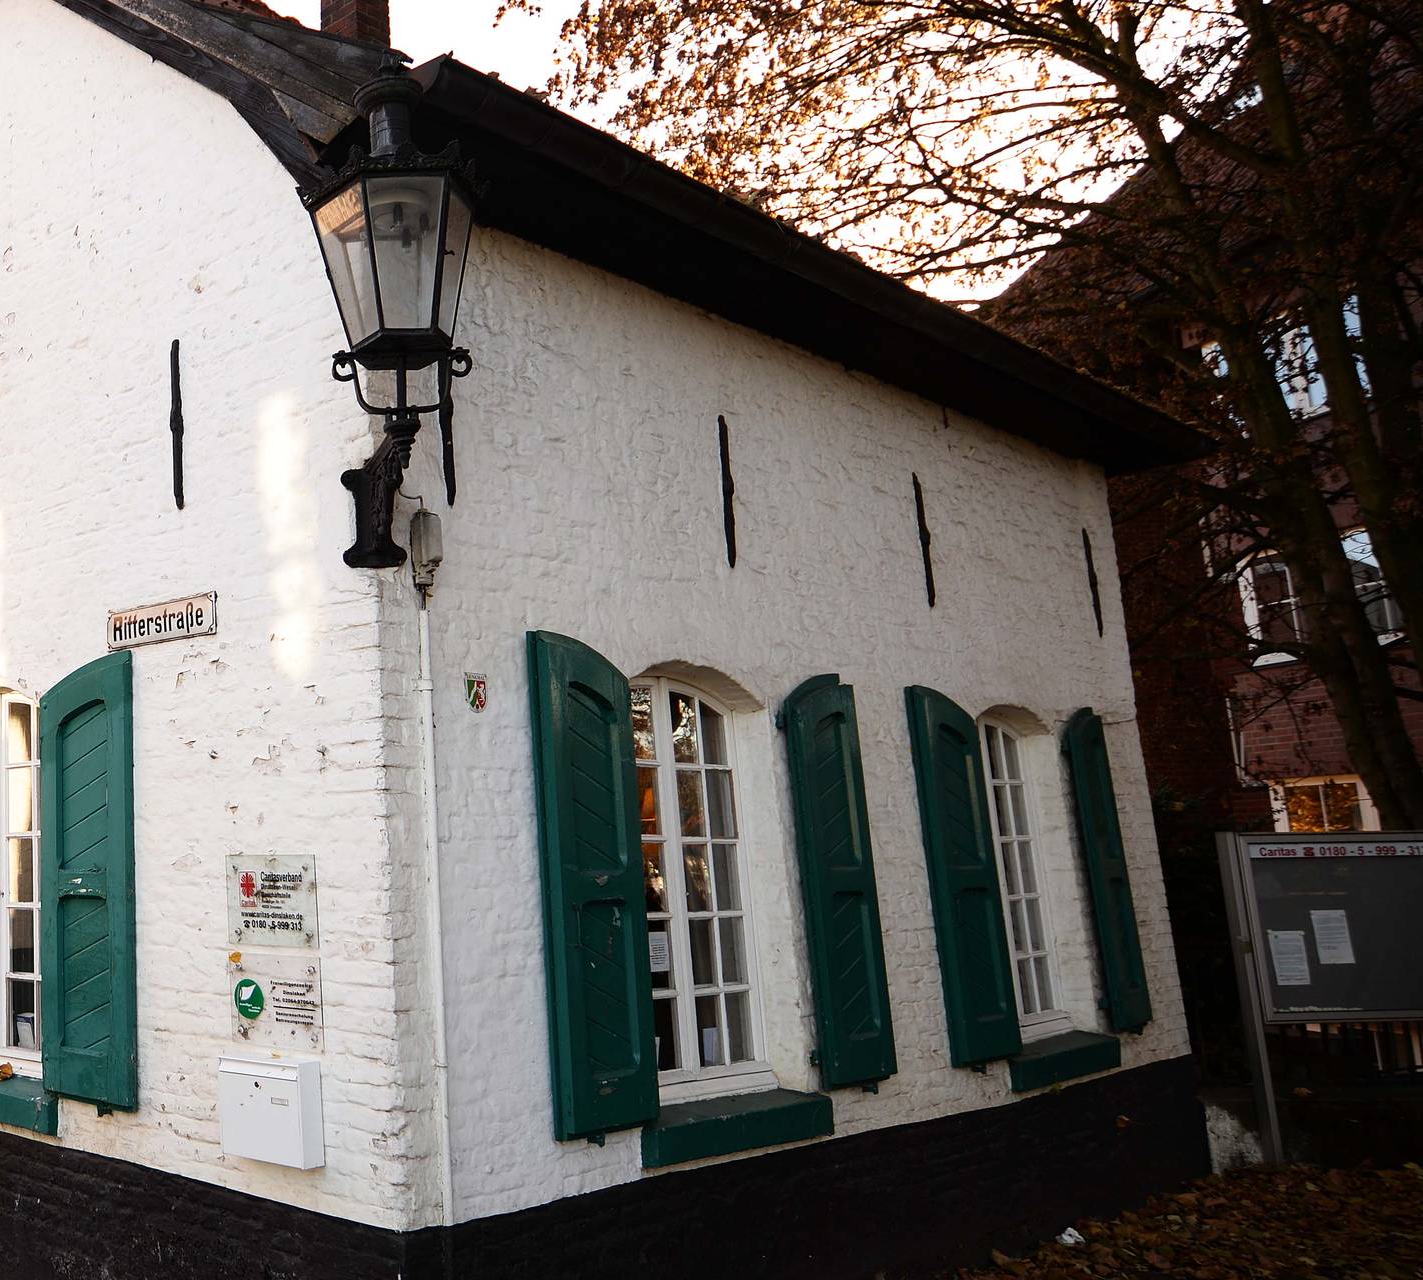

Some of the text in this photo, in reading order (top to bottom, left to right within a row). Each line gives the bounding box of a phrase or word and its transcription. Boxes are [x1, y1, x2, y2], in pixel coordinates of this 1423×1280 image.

[113, 602, 204, 641] Ritterstraße
[1259, 847, 1297, 857] Caritas
[1320, 846, 1347, 856] 0180
[1357, 846, 1365, 855] 5
[1375, 845, 1396, 855] 999
[1407, 845, 1423, 855] 31
[260, 871, 302, 883] Caritasverband
[251, 919, 267, 928] 0180
[290, 921, 302, 931] 313
